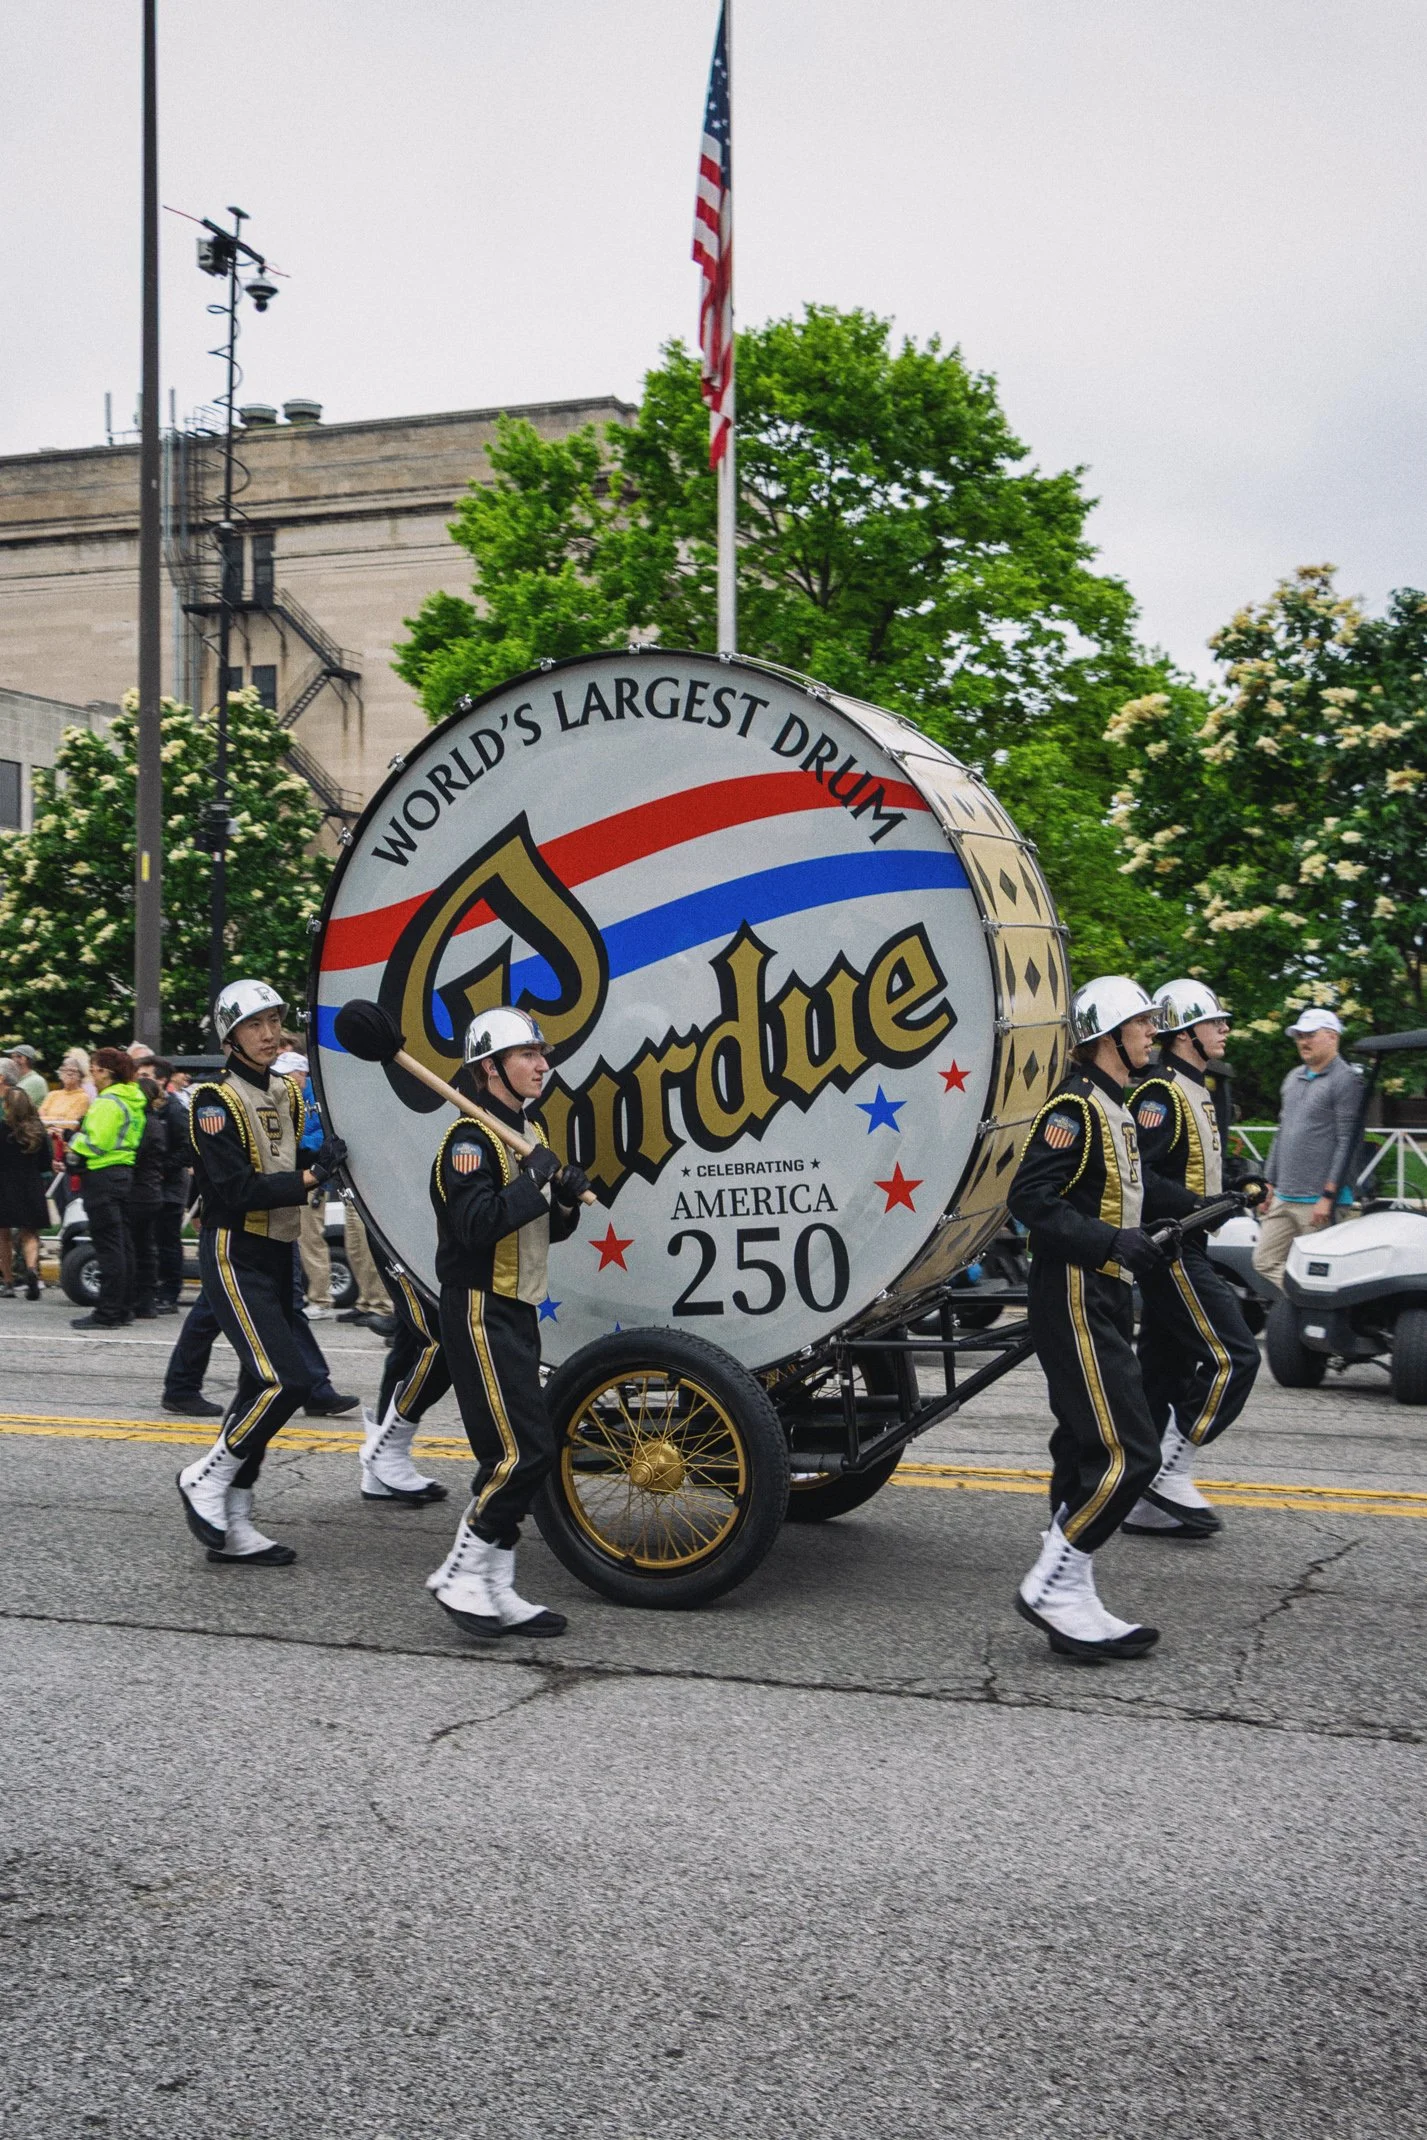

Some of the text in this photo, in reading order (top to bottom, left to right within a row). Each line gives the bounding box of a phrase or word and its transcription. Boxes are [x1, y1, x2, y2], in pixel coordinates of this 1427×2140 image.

[371, 676, 907, 867] WORLD'S LARGEST DRUM
[378, 810, 957, 1208] Purdue
[670, 1182, 839, 1221] AMERICA
[696, 1159, 805, 1178] CELEBRATING
[667, 1222, 850, 1317] 250
